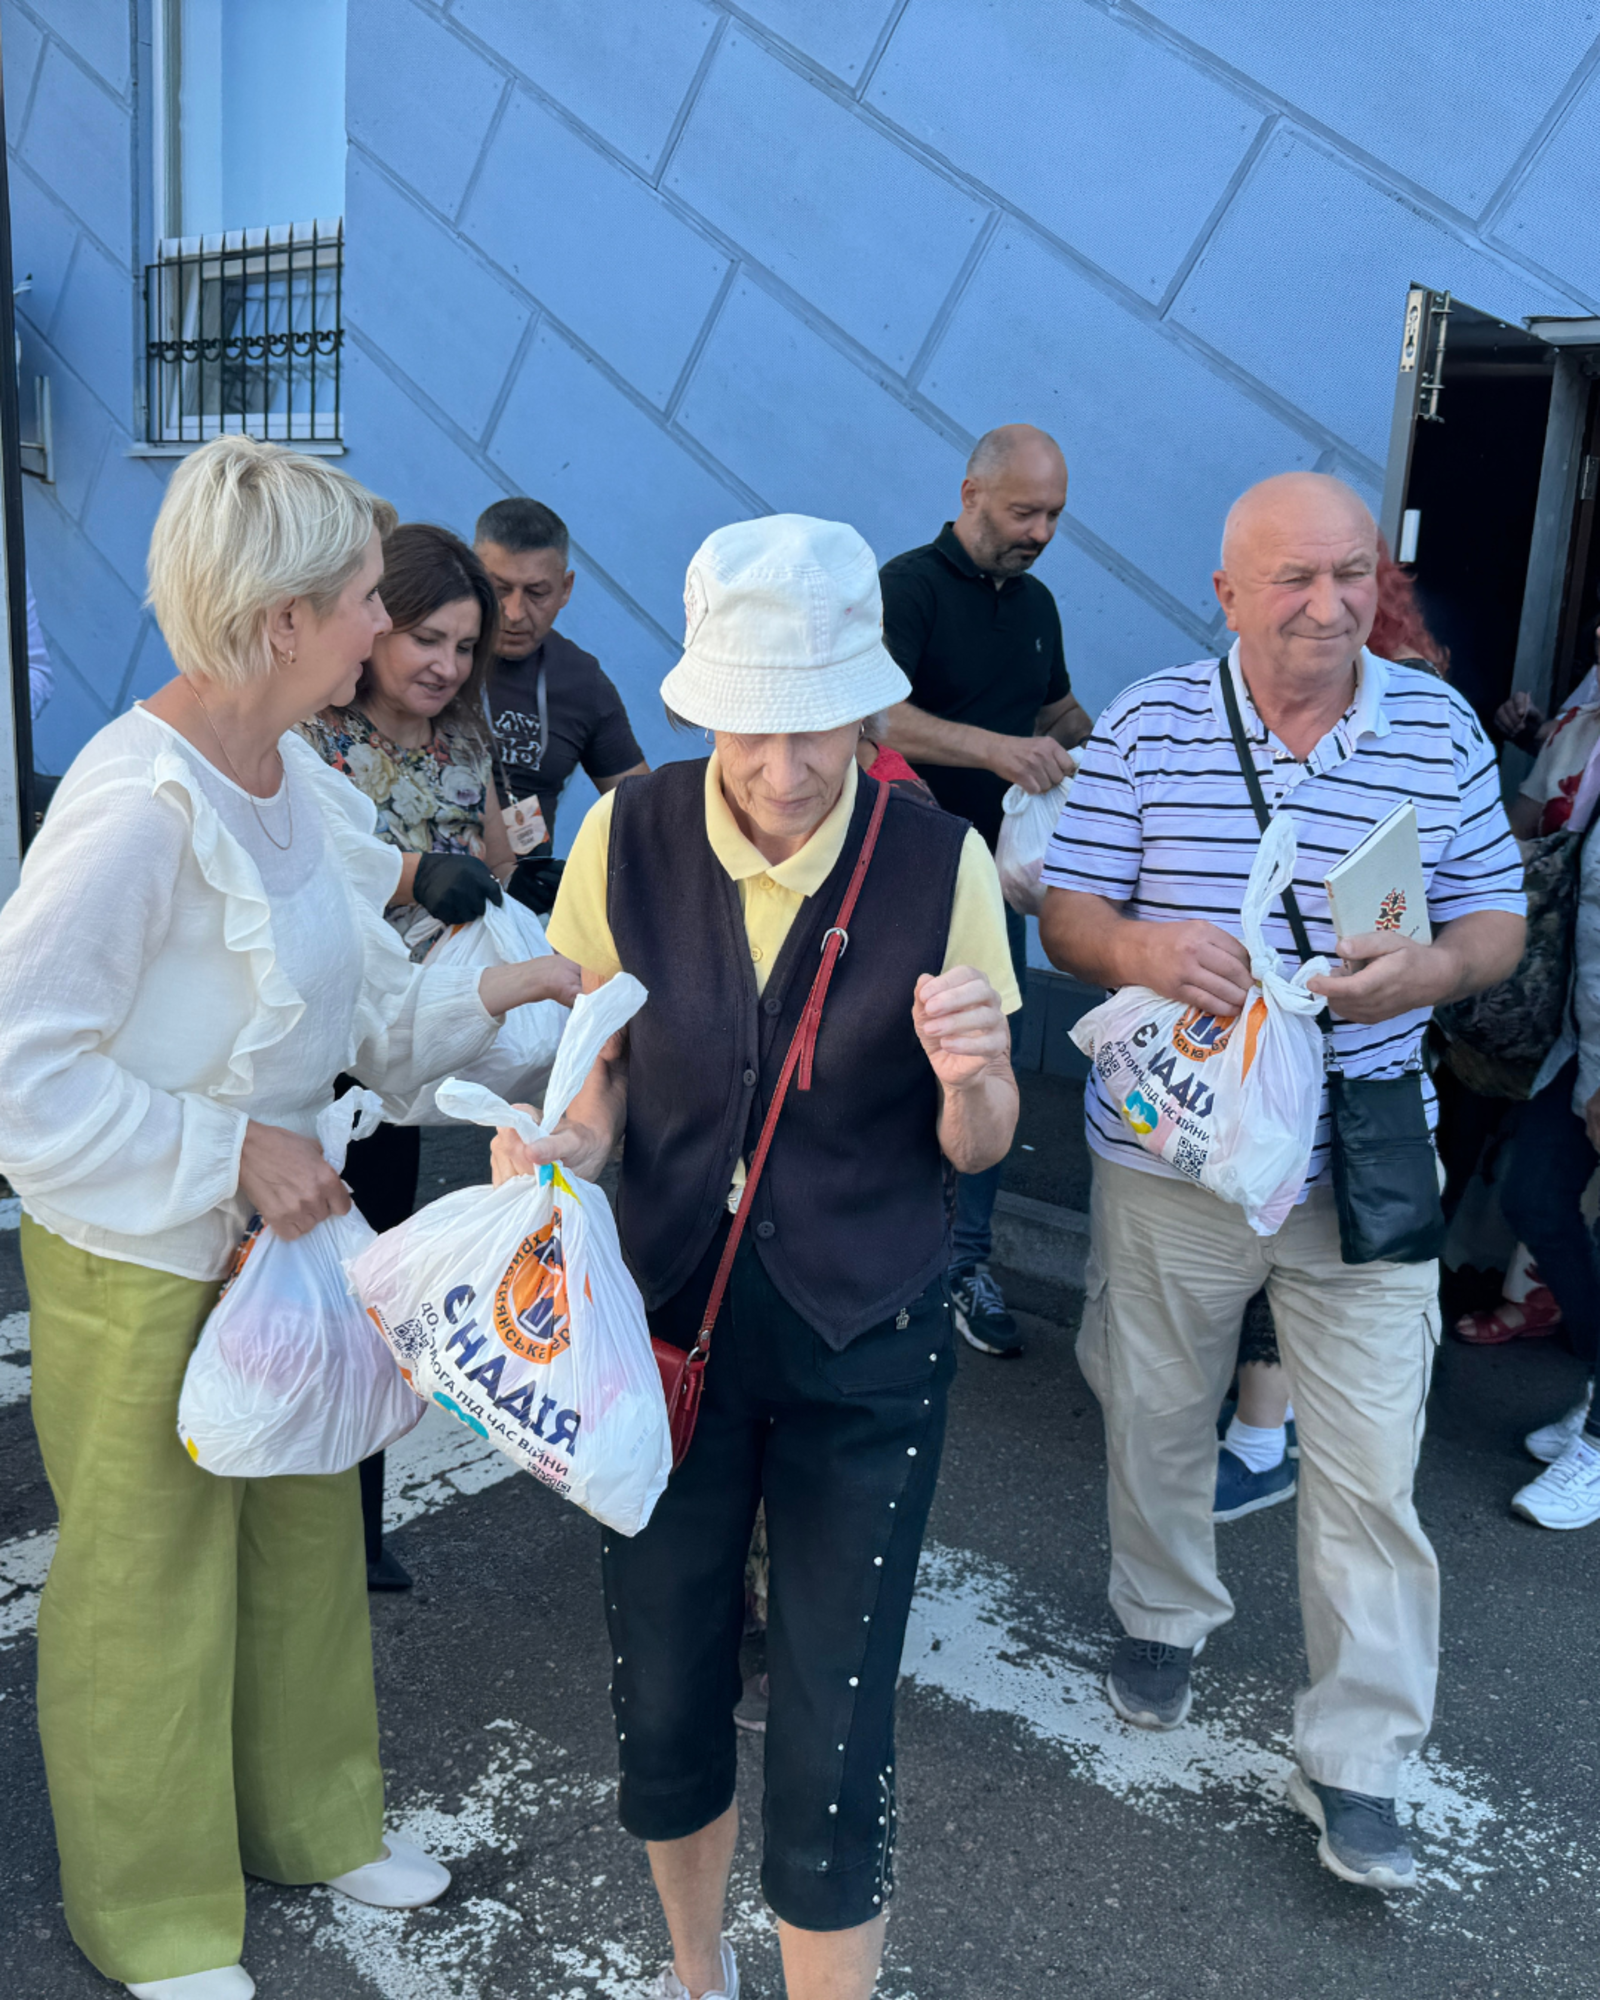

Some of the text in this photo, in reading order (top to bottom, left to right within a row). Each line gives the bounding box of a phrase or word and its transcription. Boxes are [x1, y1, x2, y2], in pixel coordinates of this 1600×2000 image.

[445, 1318, 581, 1457] НАДІЯ
[456, 1390, 485, 1419] ПІД
[487, 1413, 518, 1441] ЧАС
[518, 1438, 568, 1476] ВІЙНИ
